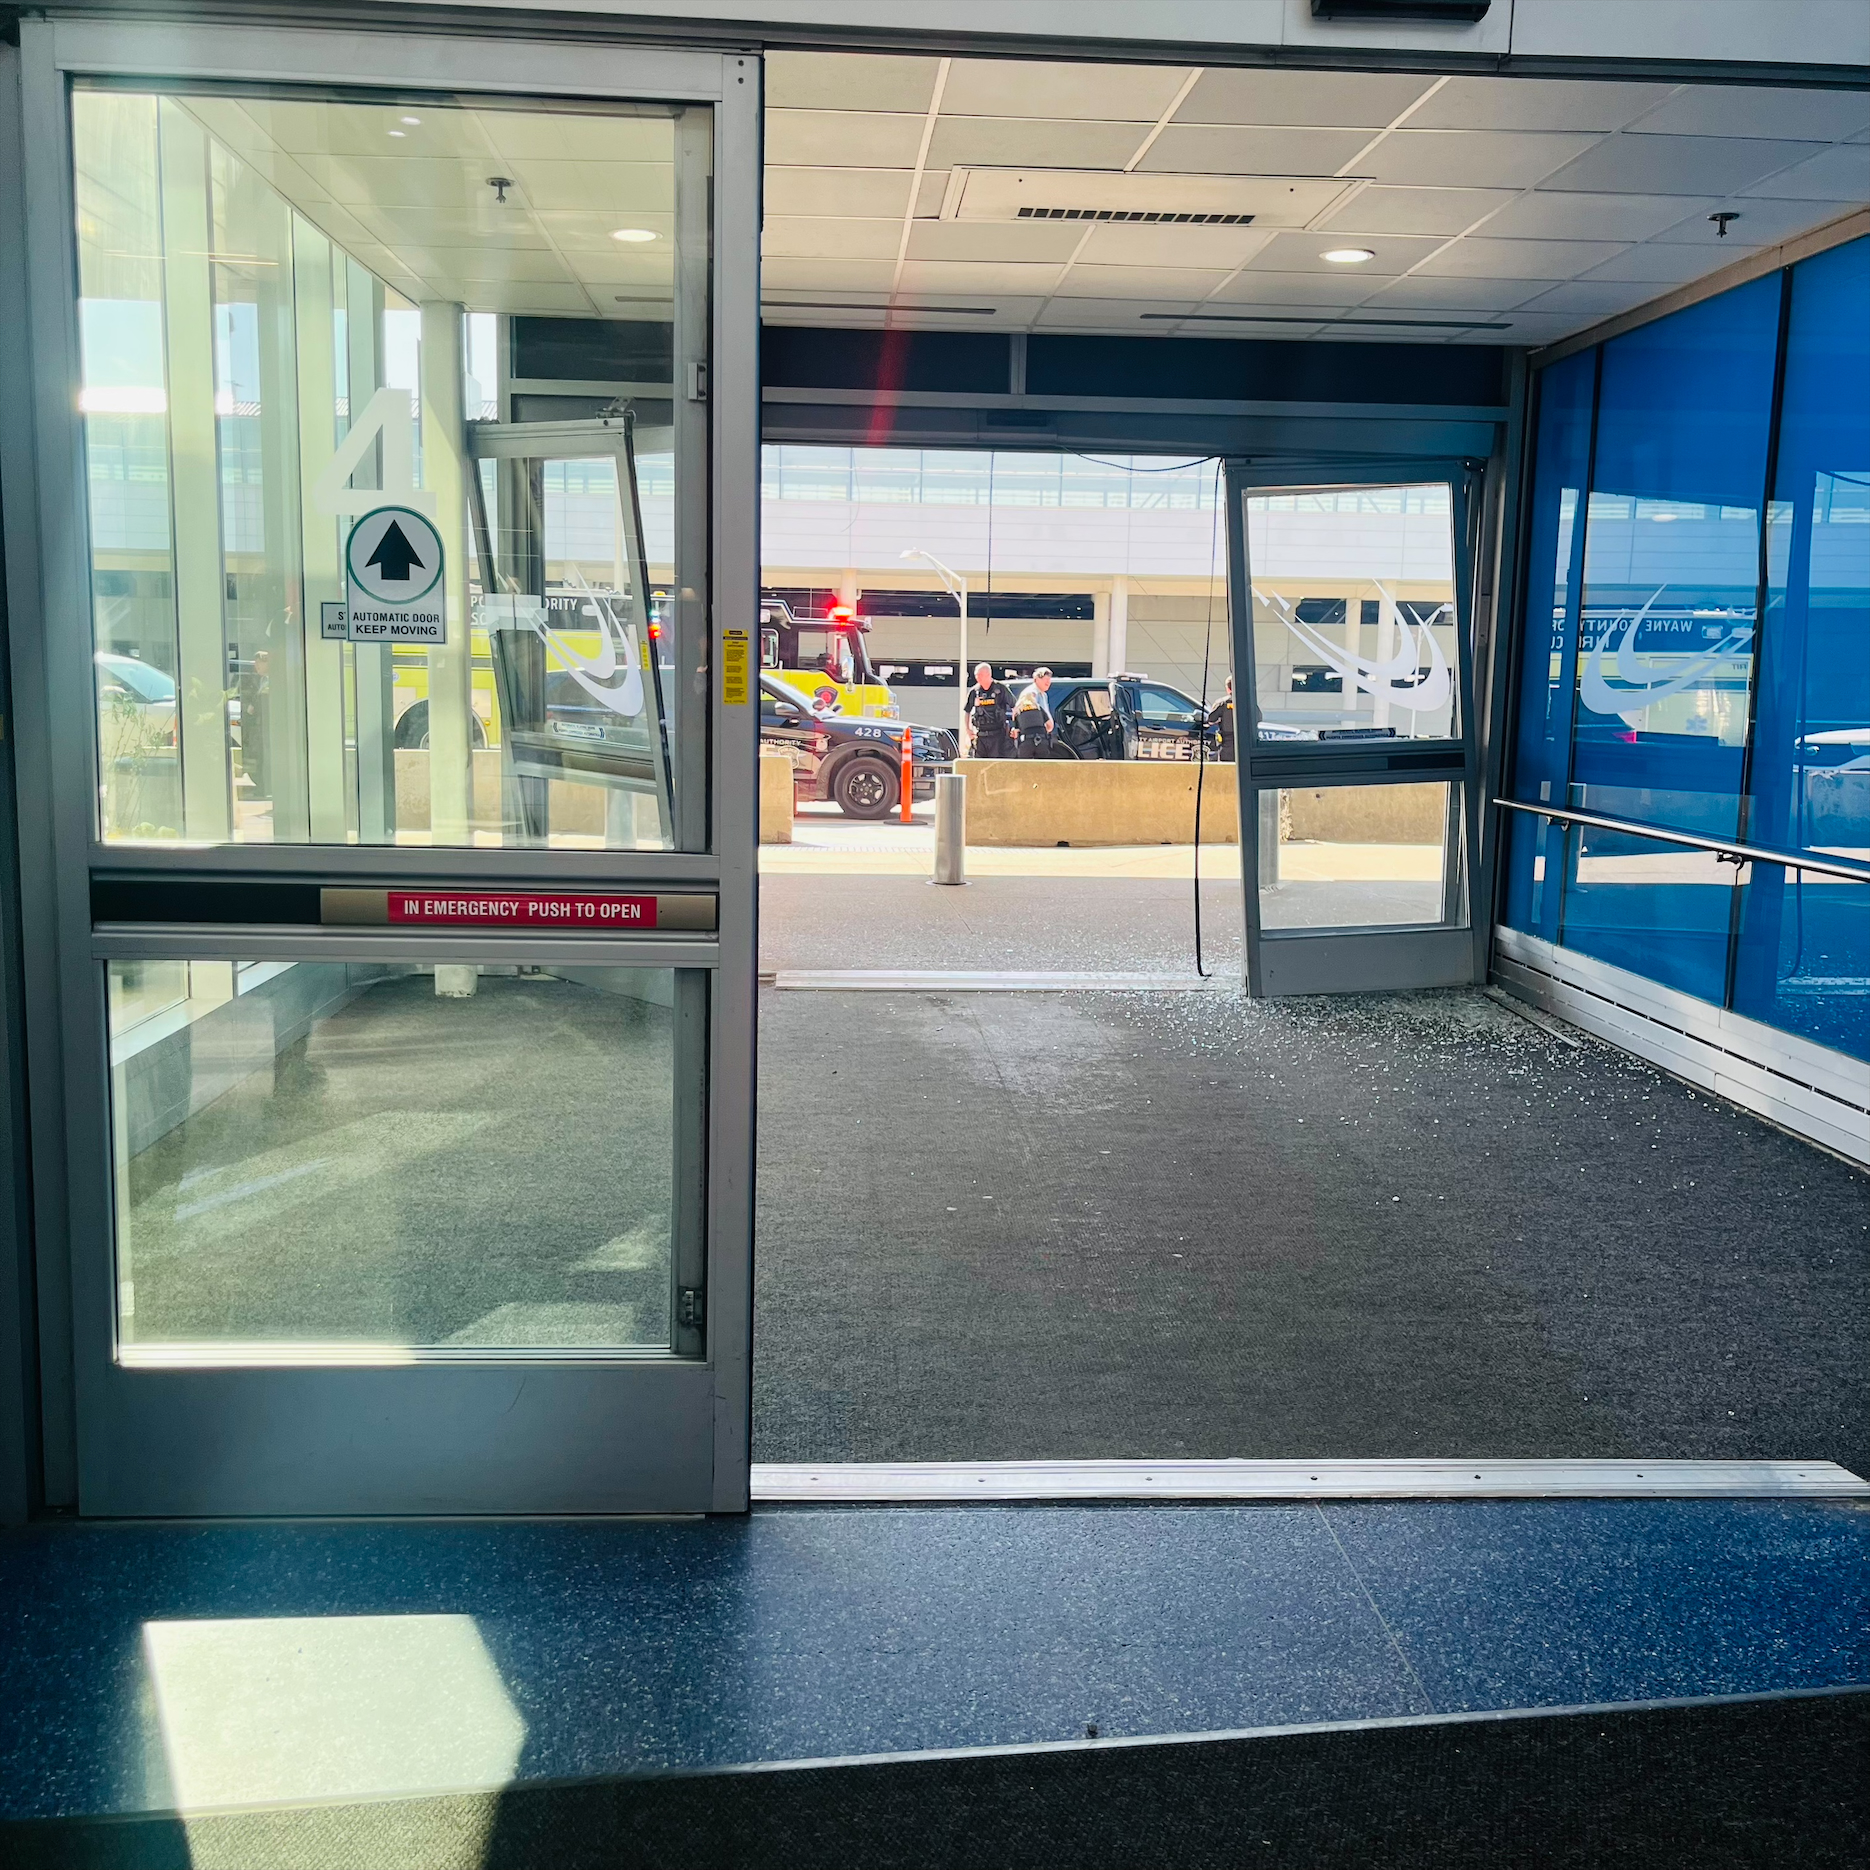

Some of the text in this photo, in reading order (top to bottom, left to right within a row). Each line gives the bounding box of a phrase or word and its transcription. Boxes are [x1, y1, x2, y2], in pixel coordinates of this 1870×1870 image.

[314, 387, 436, 518] 4
[352, 611, 440, 623] AUTOMATIC DOOR
[327, 623, 347, 631] AUTO
[355, 624, 438, 636] KEEP MOVING
[854, 727, 882, 738] 428
[404, 899, 641, 920] IN EMERGENCY PUSH TO OPEN
